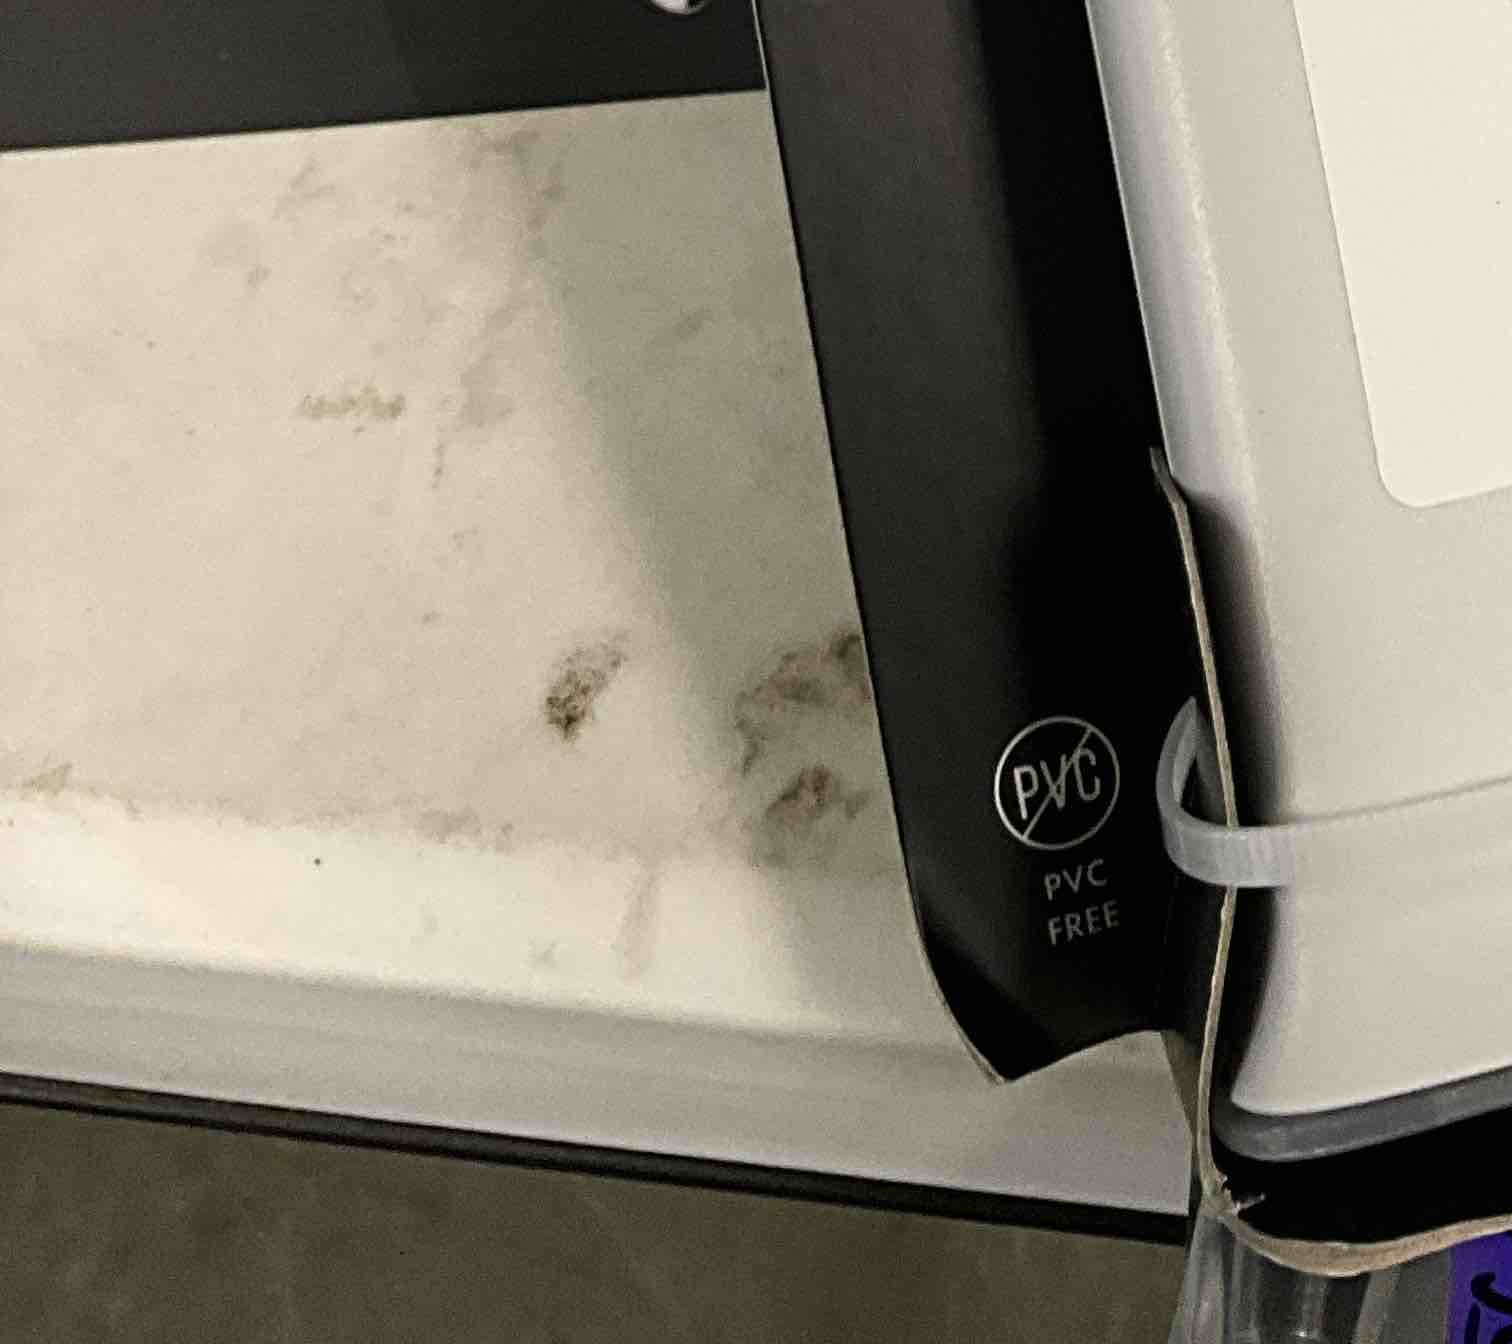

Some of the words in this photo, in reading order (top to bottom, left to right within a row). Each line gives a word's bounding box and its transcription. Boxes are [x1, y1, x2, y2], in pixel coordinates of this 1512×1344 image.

[1013, 747, 1100, 820] PVC
[1044, 858, 1108, 901] PVC
[1048, 899, 1120, 945] FREE
